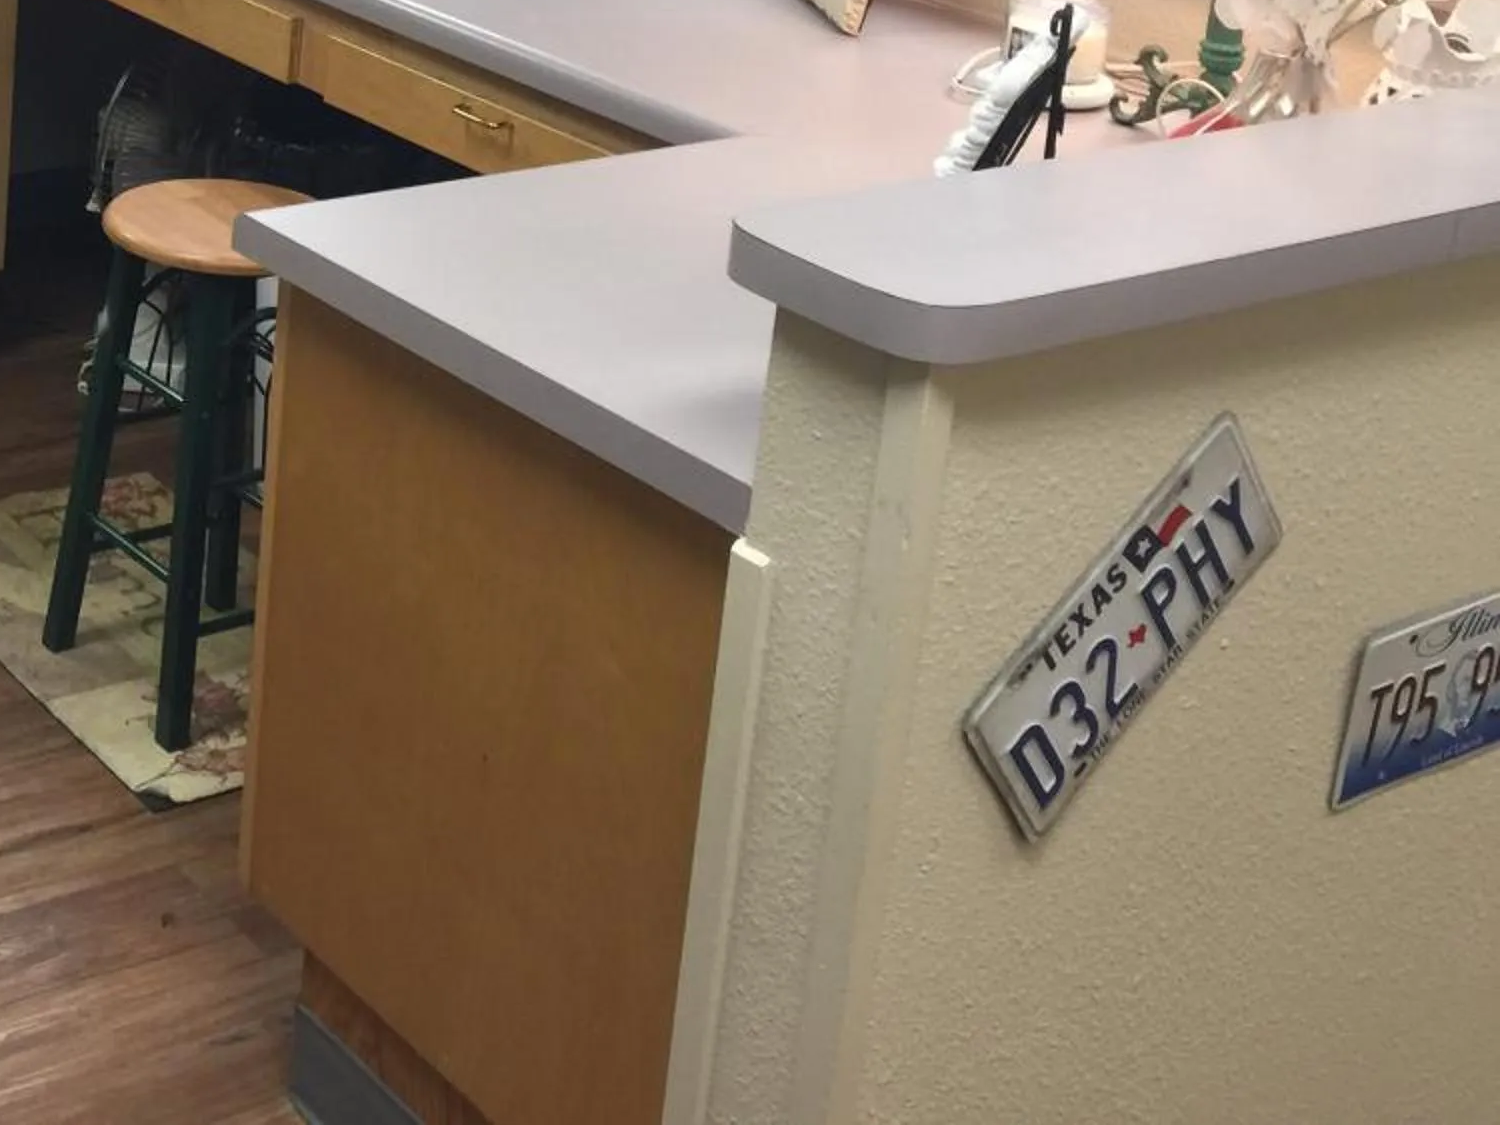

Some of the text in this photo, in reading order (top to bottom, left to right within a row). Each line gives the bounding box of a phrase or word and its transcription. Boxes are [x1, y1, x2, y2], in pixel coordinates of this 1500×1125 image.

[1009, 477, 1255, 811] D32 PHY
[1039, 562, 1127, 672] TEXAS
[1361, 643, 1500, 768] T95 9
